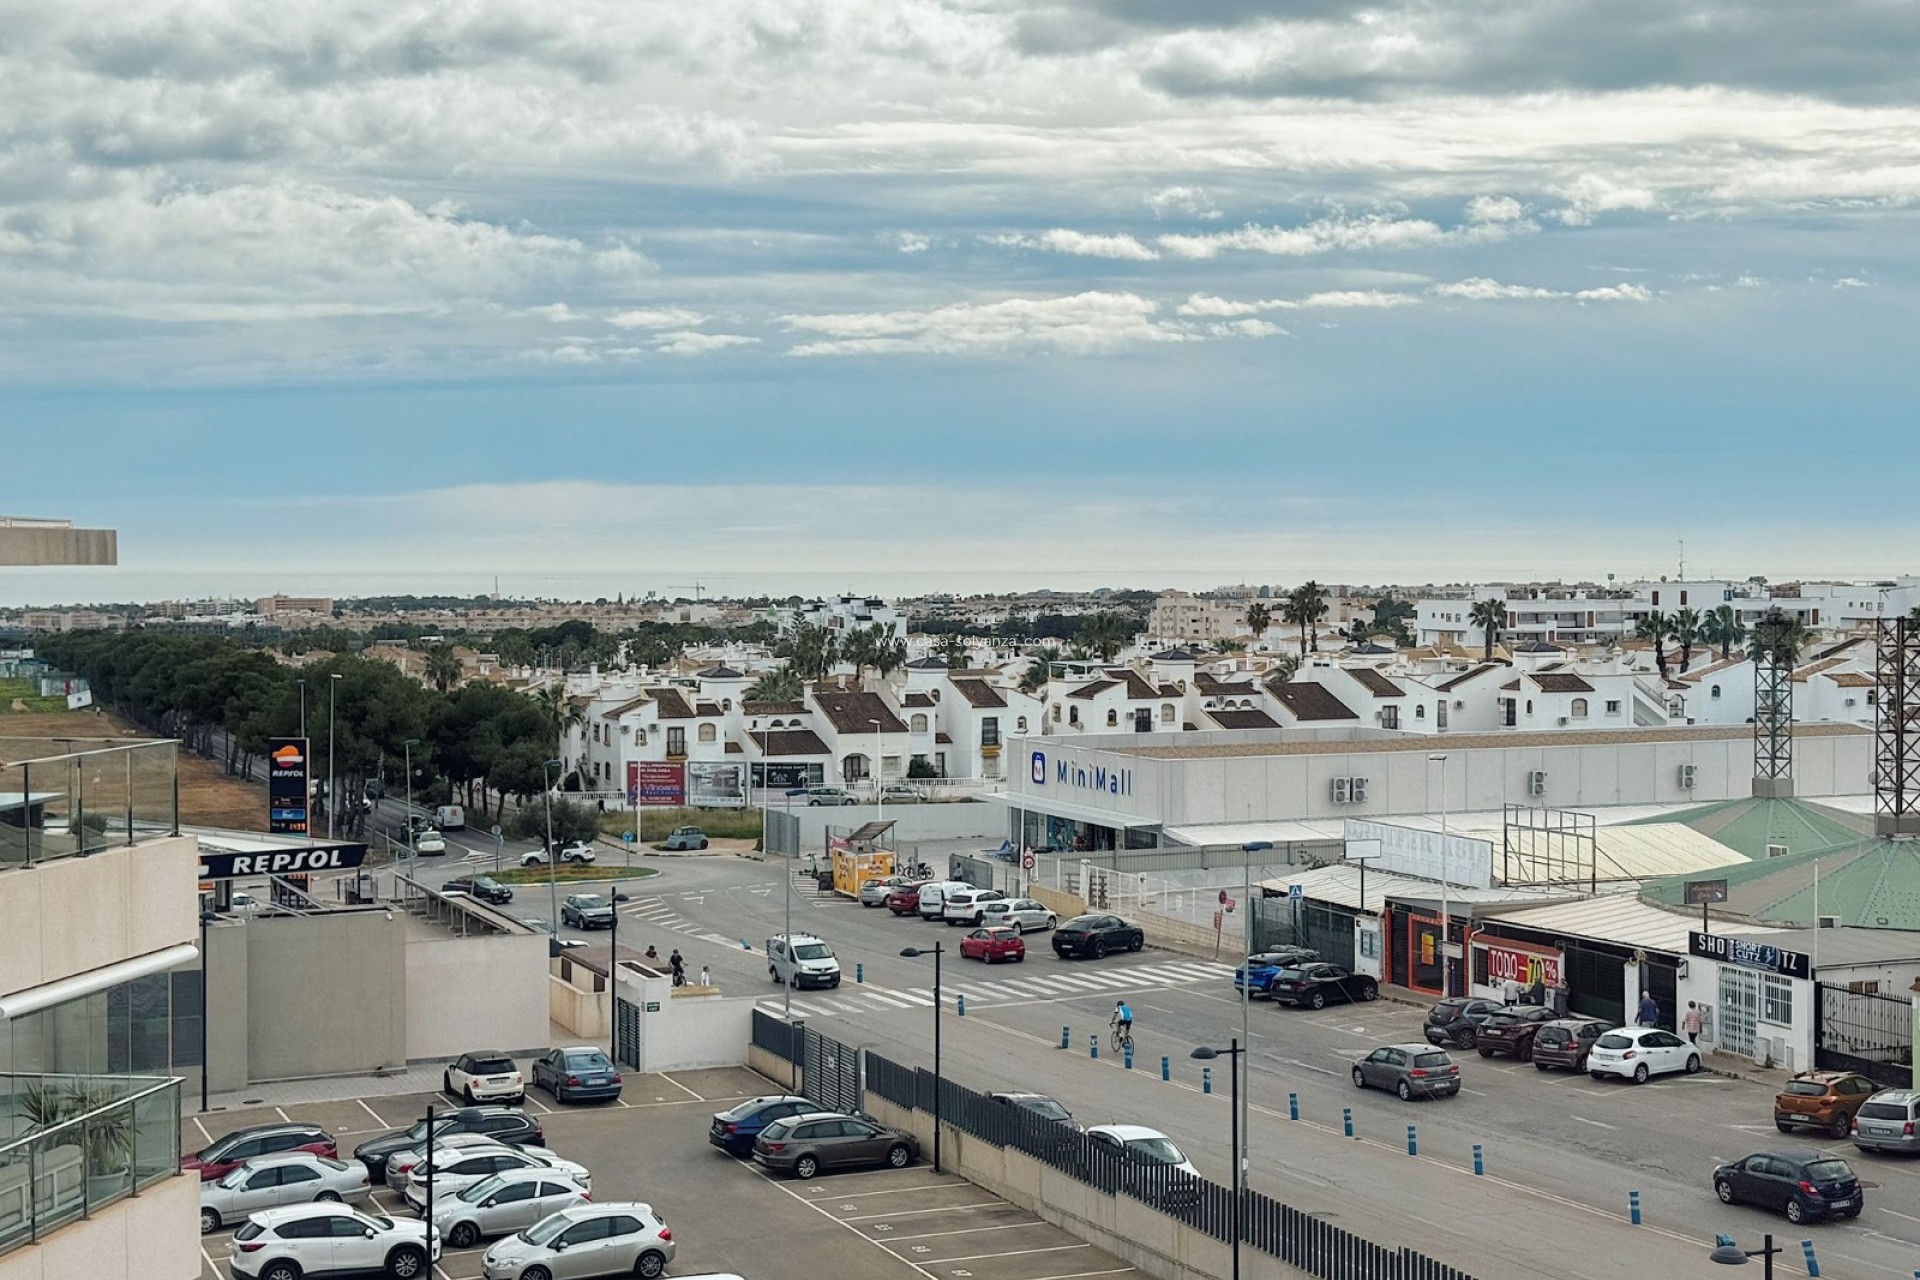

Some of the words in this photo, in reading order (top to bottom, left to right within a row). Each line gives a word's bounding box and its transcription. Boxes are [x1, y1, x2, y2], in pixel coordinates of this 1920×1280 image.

[272, 770, 304, 778] REPSOL
[1057, 759, 1132, 797] MiniMall
[232, 850, 342, 875] REPSOL
[1735, 940, 1761, 952] SHORT
[1736, 950, 1760, 961] CUTZ
[1490, 950, 1518, 980] TODO
